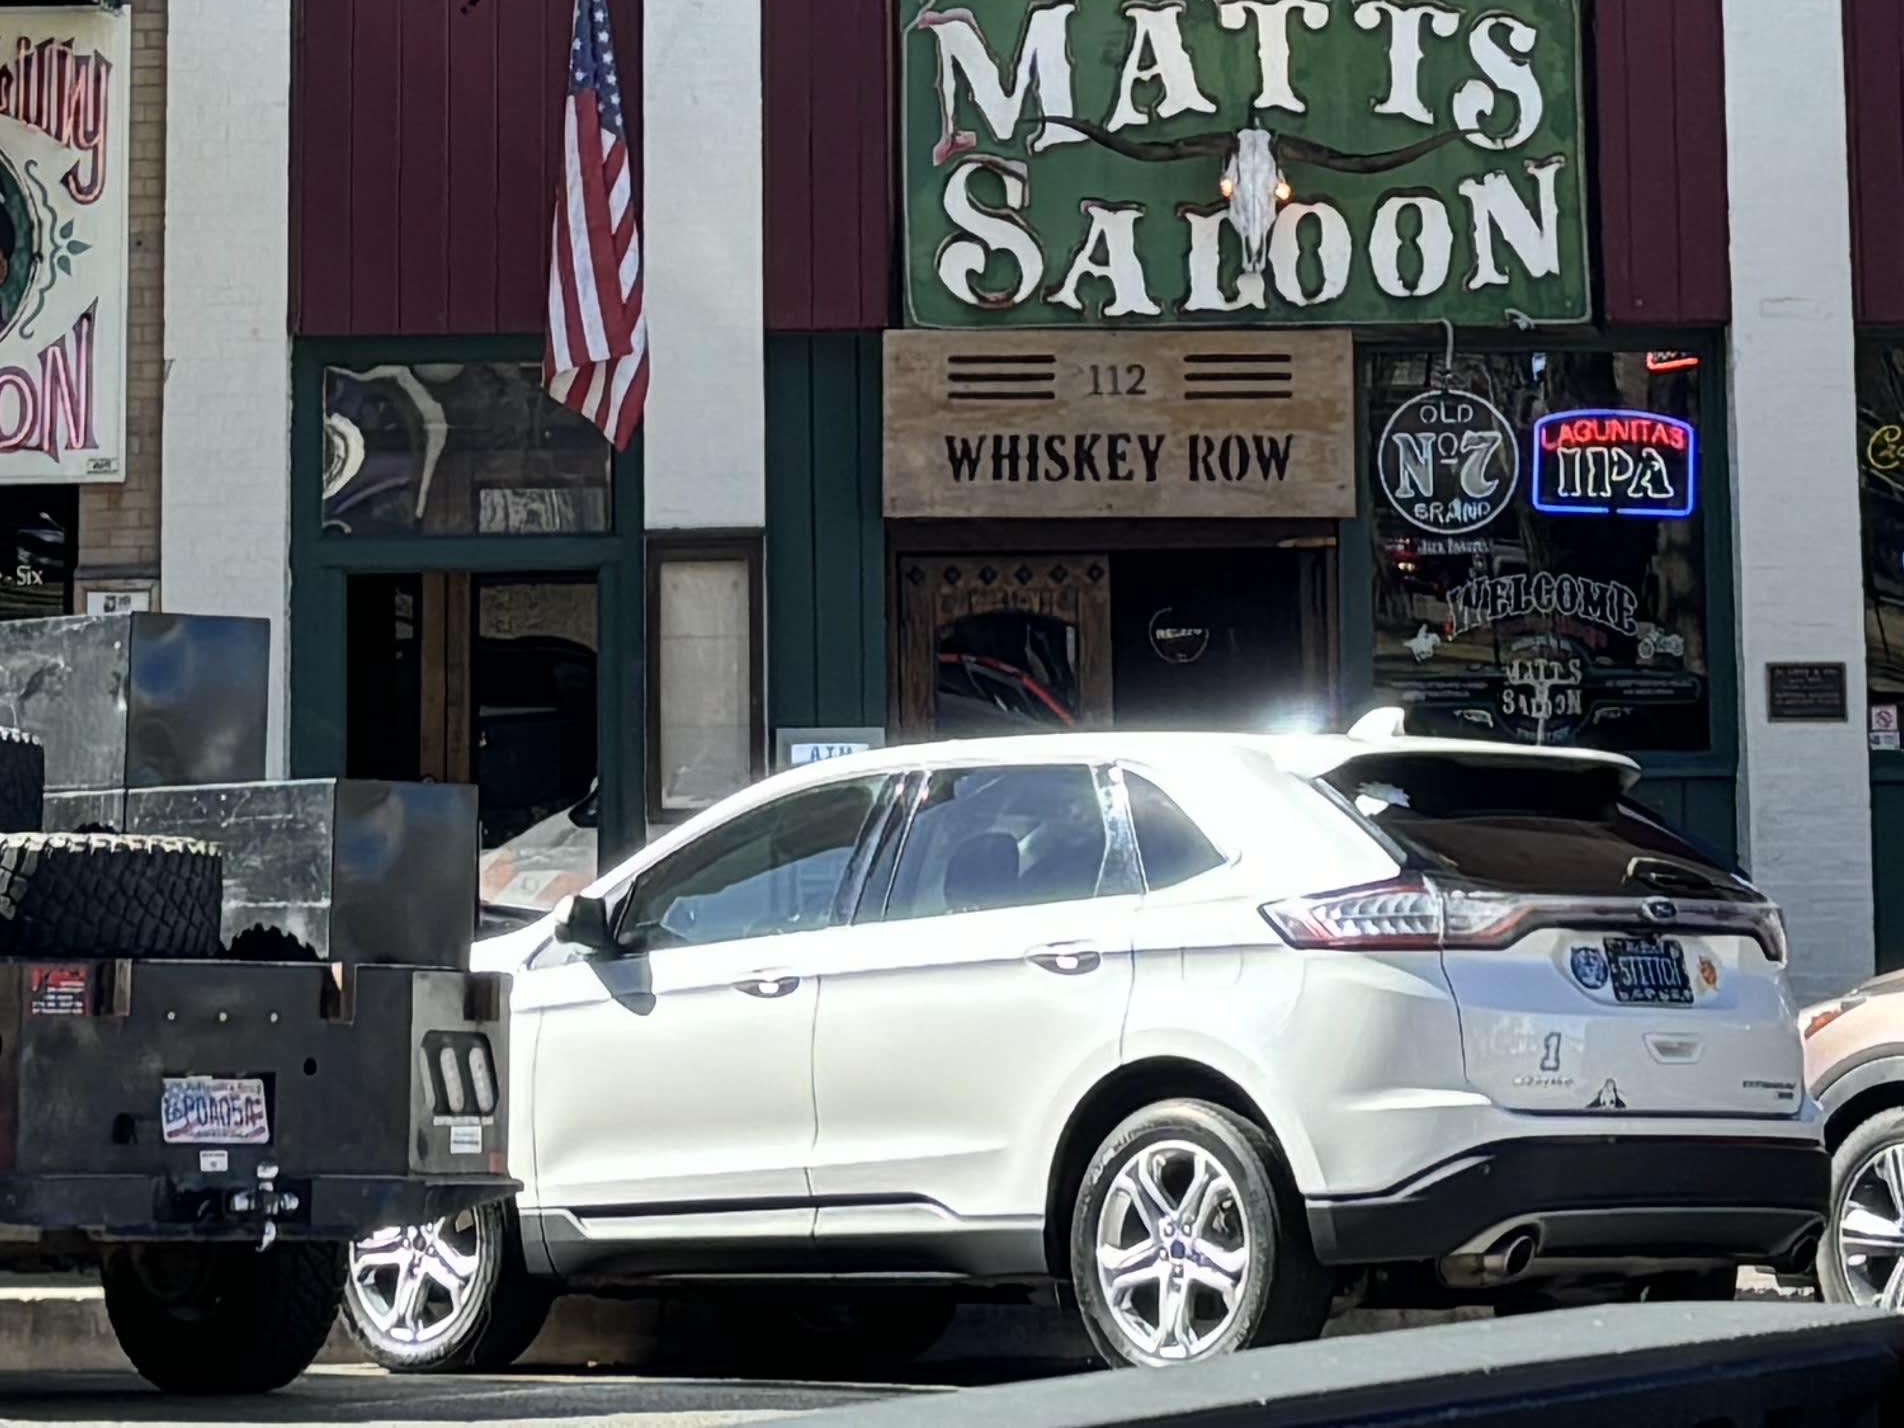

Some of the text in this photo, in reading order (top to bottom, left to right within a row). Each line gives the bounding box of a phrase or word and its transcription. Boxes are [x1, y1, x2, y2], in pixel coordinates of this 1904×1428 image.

[934, 153, 1566, 319] SALOON
[1086, 363, 1147, 397] 112
[1419, 401, 1474, 424] OLD
[1541, 419, 1686, 451] LAGUNITAS
[945, 433, 1294, 483] WHISKEY ROW
[1413, 499, 1491, 525] BRAND
[16, 564, 44, 587] Six
[1445, 571, 1639, 642] WELCOME
